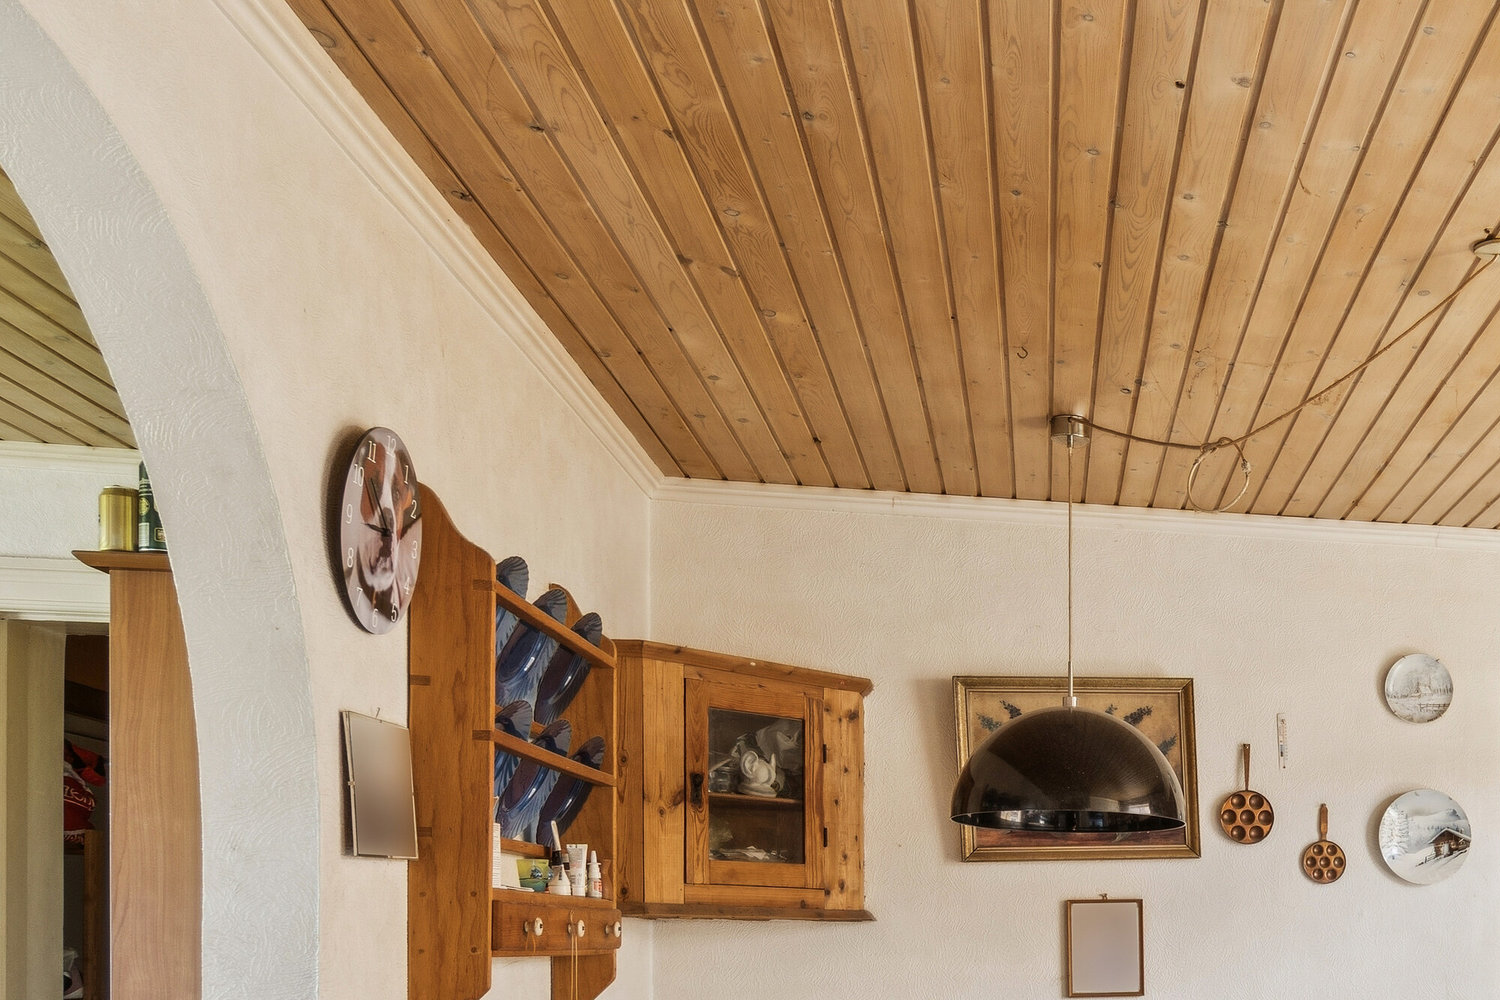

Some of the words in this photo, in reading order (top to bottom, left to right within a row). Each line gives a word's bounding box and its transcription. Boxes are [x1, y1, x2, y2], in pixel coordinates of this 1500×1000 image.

[367, 440, 377, 464] 11
[386, 434, 398, 458] 12
[352, 463, 365, 488] 10
[345, 503, 354, 525] 9
[410, 499, 417, 520] 2
[347, 547, 354, 568] 8
[411, 540, 418, 560] 3
[403, 576, 411, 595] 4
[356, 586, 363, 607] 7
[371, 608, 379, 629] 6
[390, 603, 398, 623] 5
